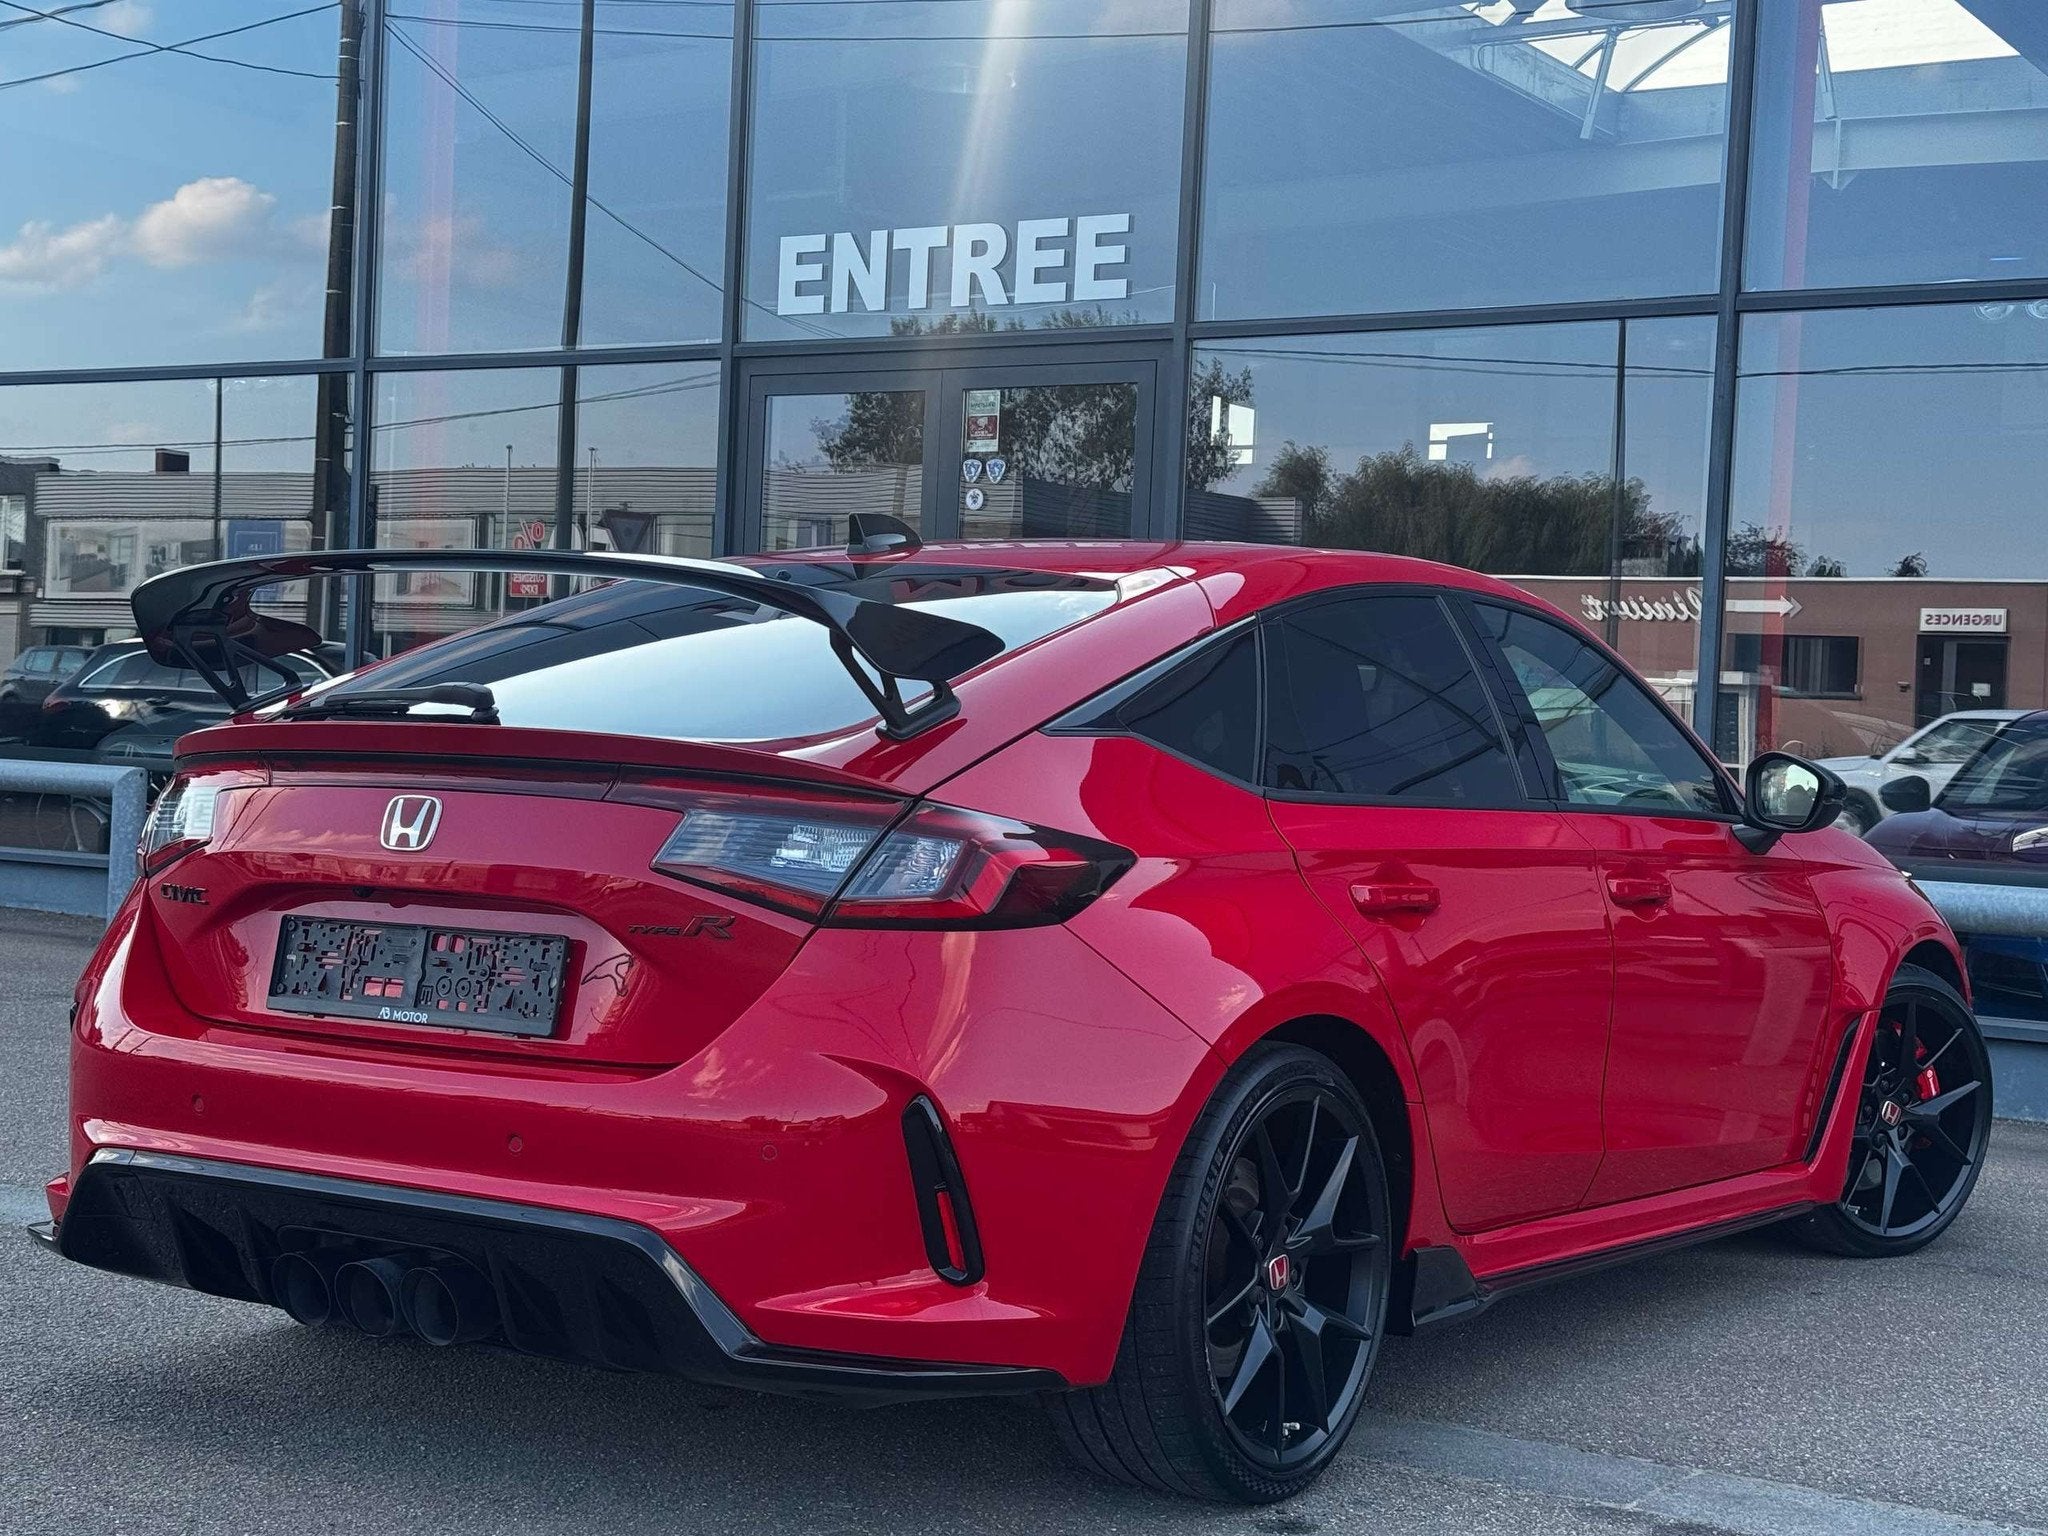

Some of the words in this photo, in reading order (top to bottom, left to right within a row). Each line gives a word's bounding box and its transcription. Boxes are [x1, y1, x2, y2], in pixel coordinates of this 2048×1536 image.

[778, 213, 1130, 316] ENTREE
[161, 883, 209, 905] CIVIC
[629, 925, 681, 936] TYPE
[682, 914, 736, 941] R
[393, 1010, 428, 1024] MOTOR
[1190, 1147, 1225, 1262] MICHELIN
